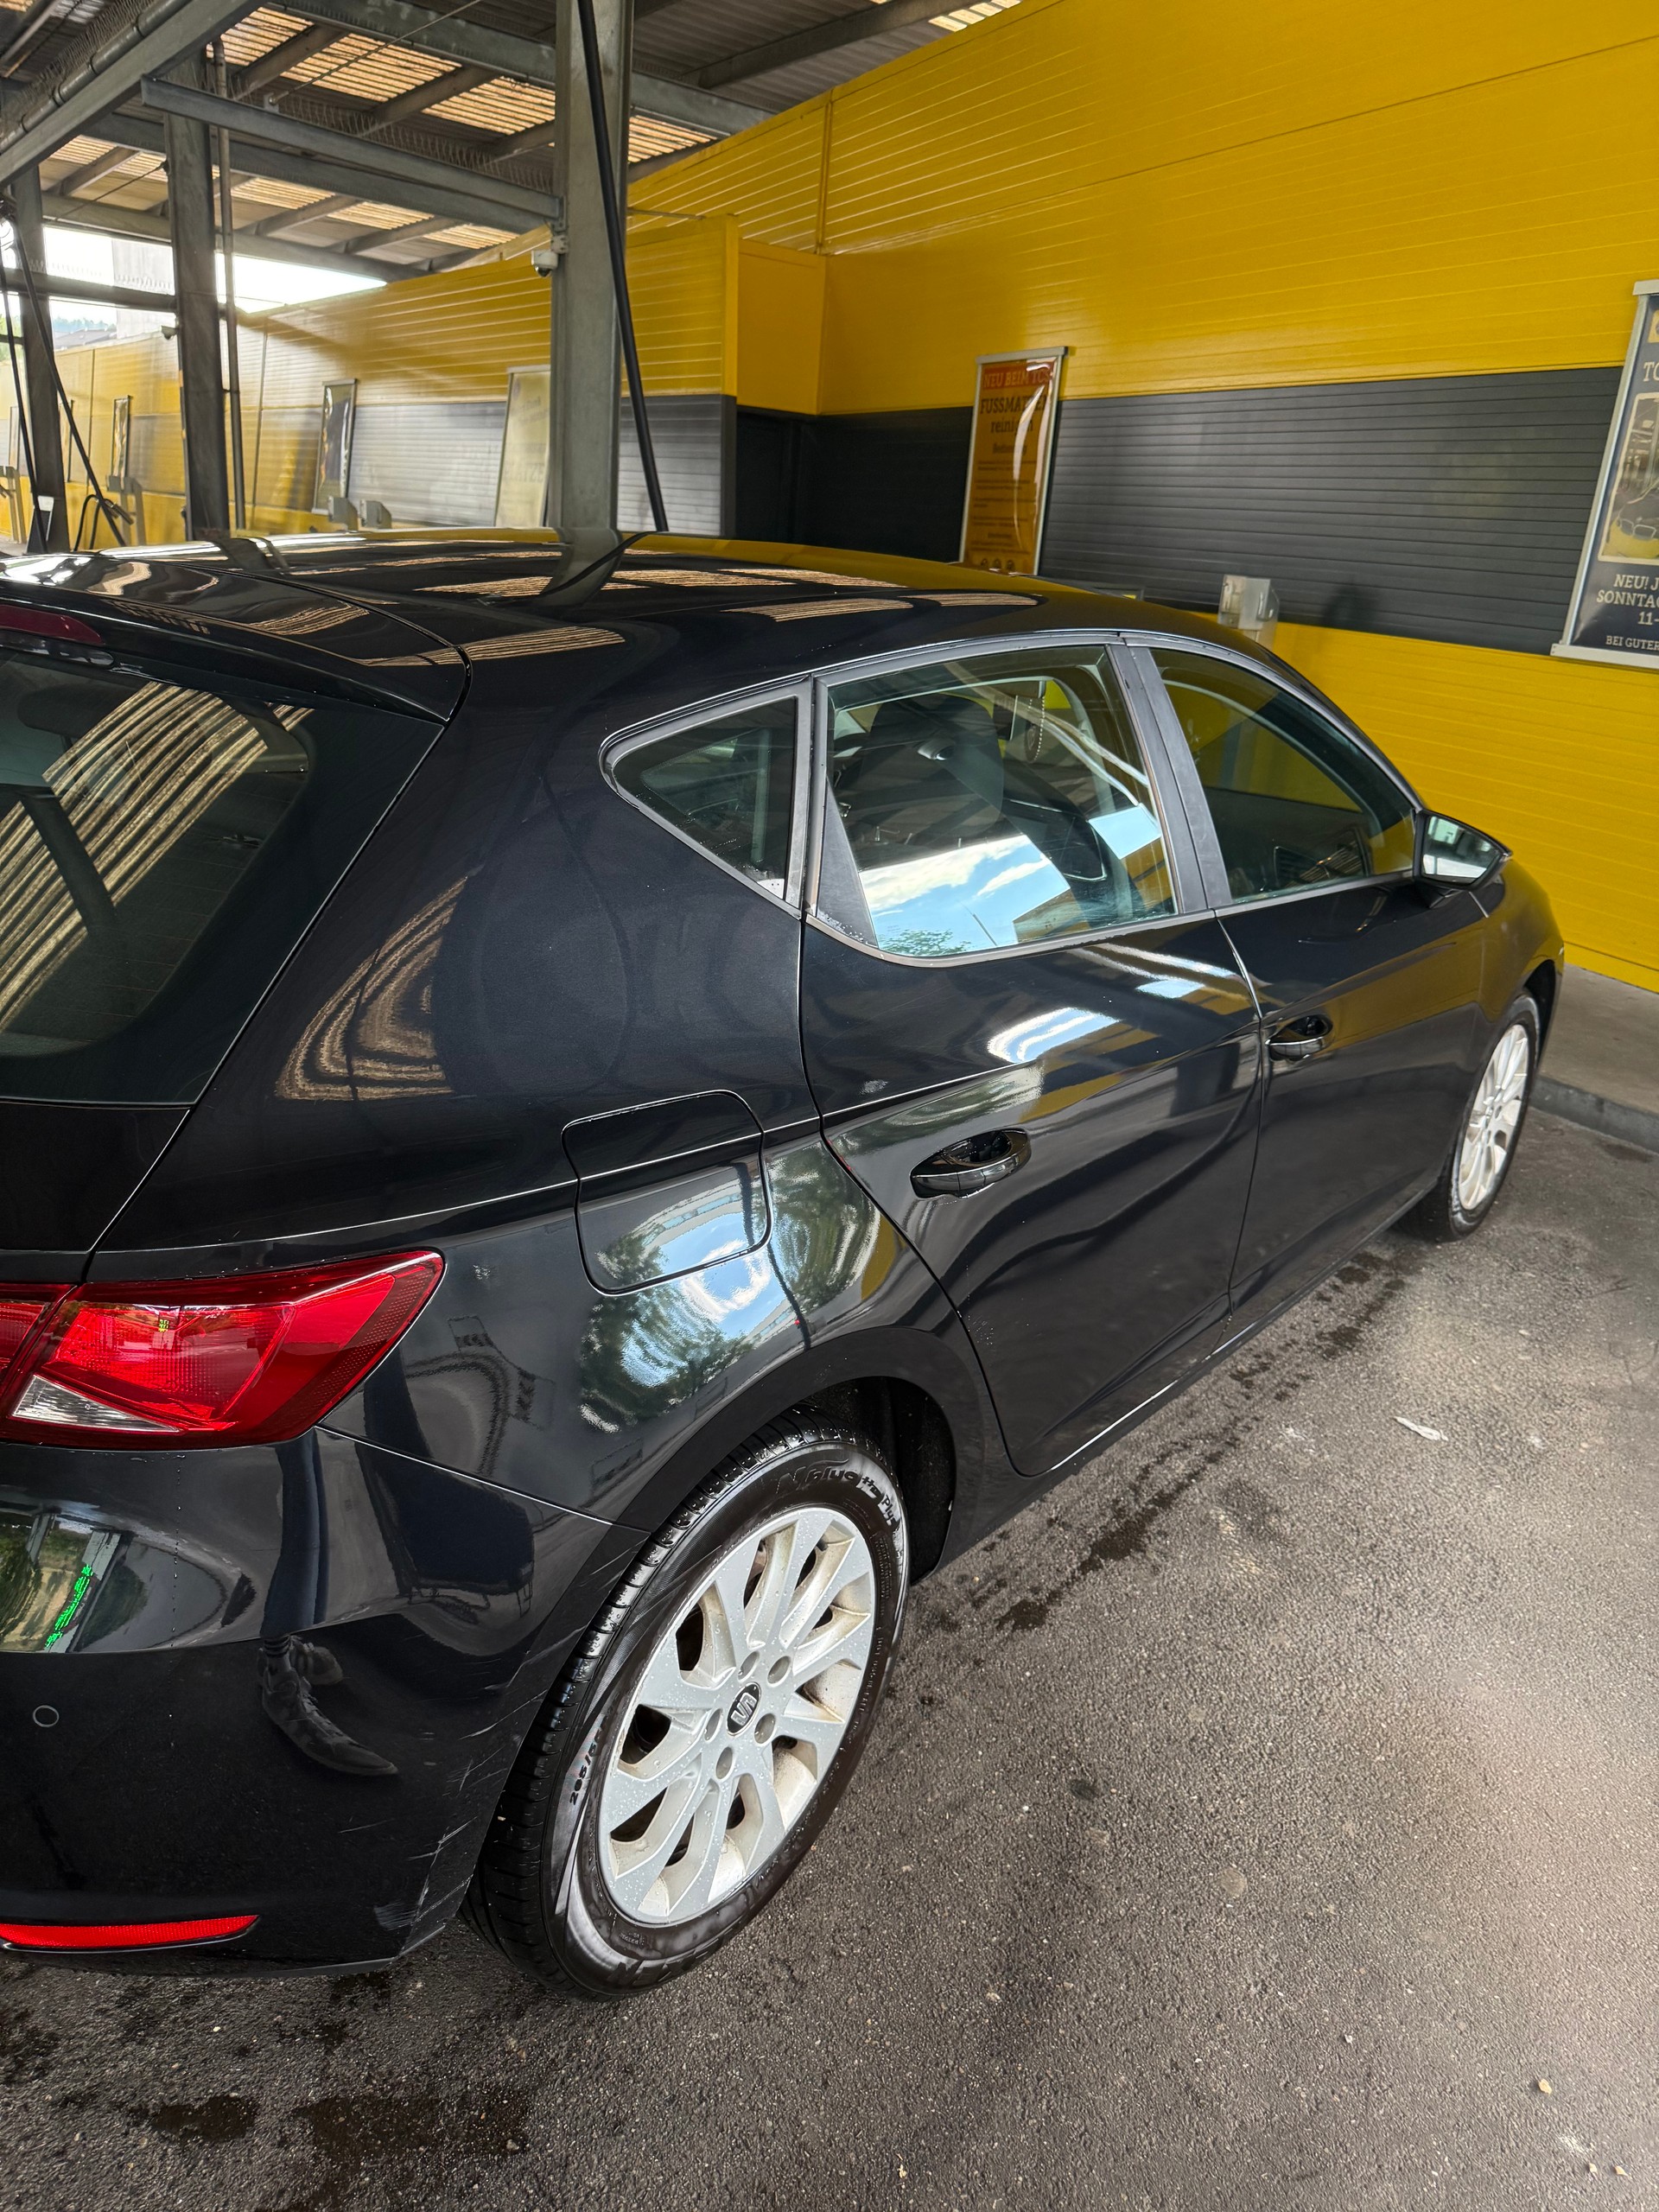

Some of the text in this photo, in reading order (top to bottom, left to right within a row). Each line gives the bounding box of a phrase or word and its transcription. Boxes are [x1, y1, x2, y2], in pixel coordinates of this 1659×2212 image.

[984, 372, 1002, 388] NEU
[1005, 370, 1029, 386] BEIM
[1613, 574, 1649, 590] NEU!
[1596, 589, 1659, 608] SONNTA
[1605, 635, 1624, 646] BEI
